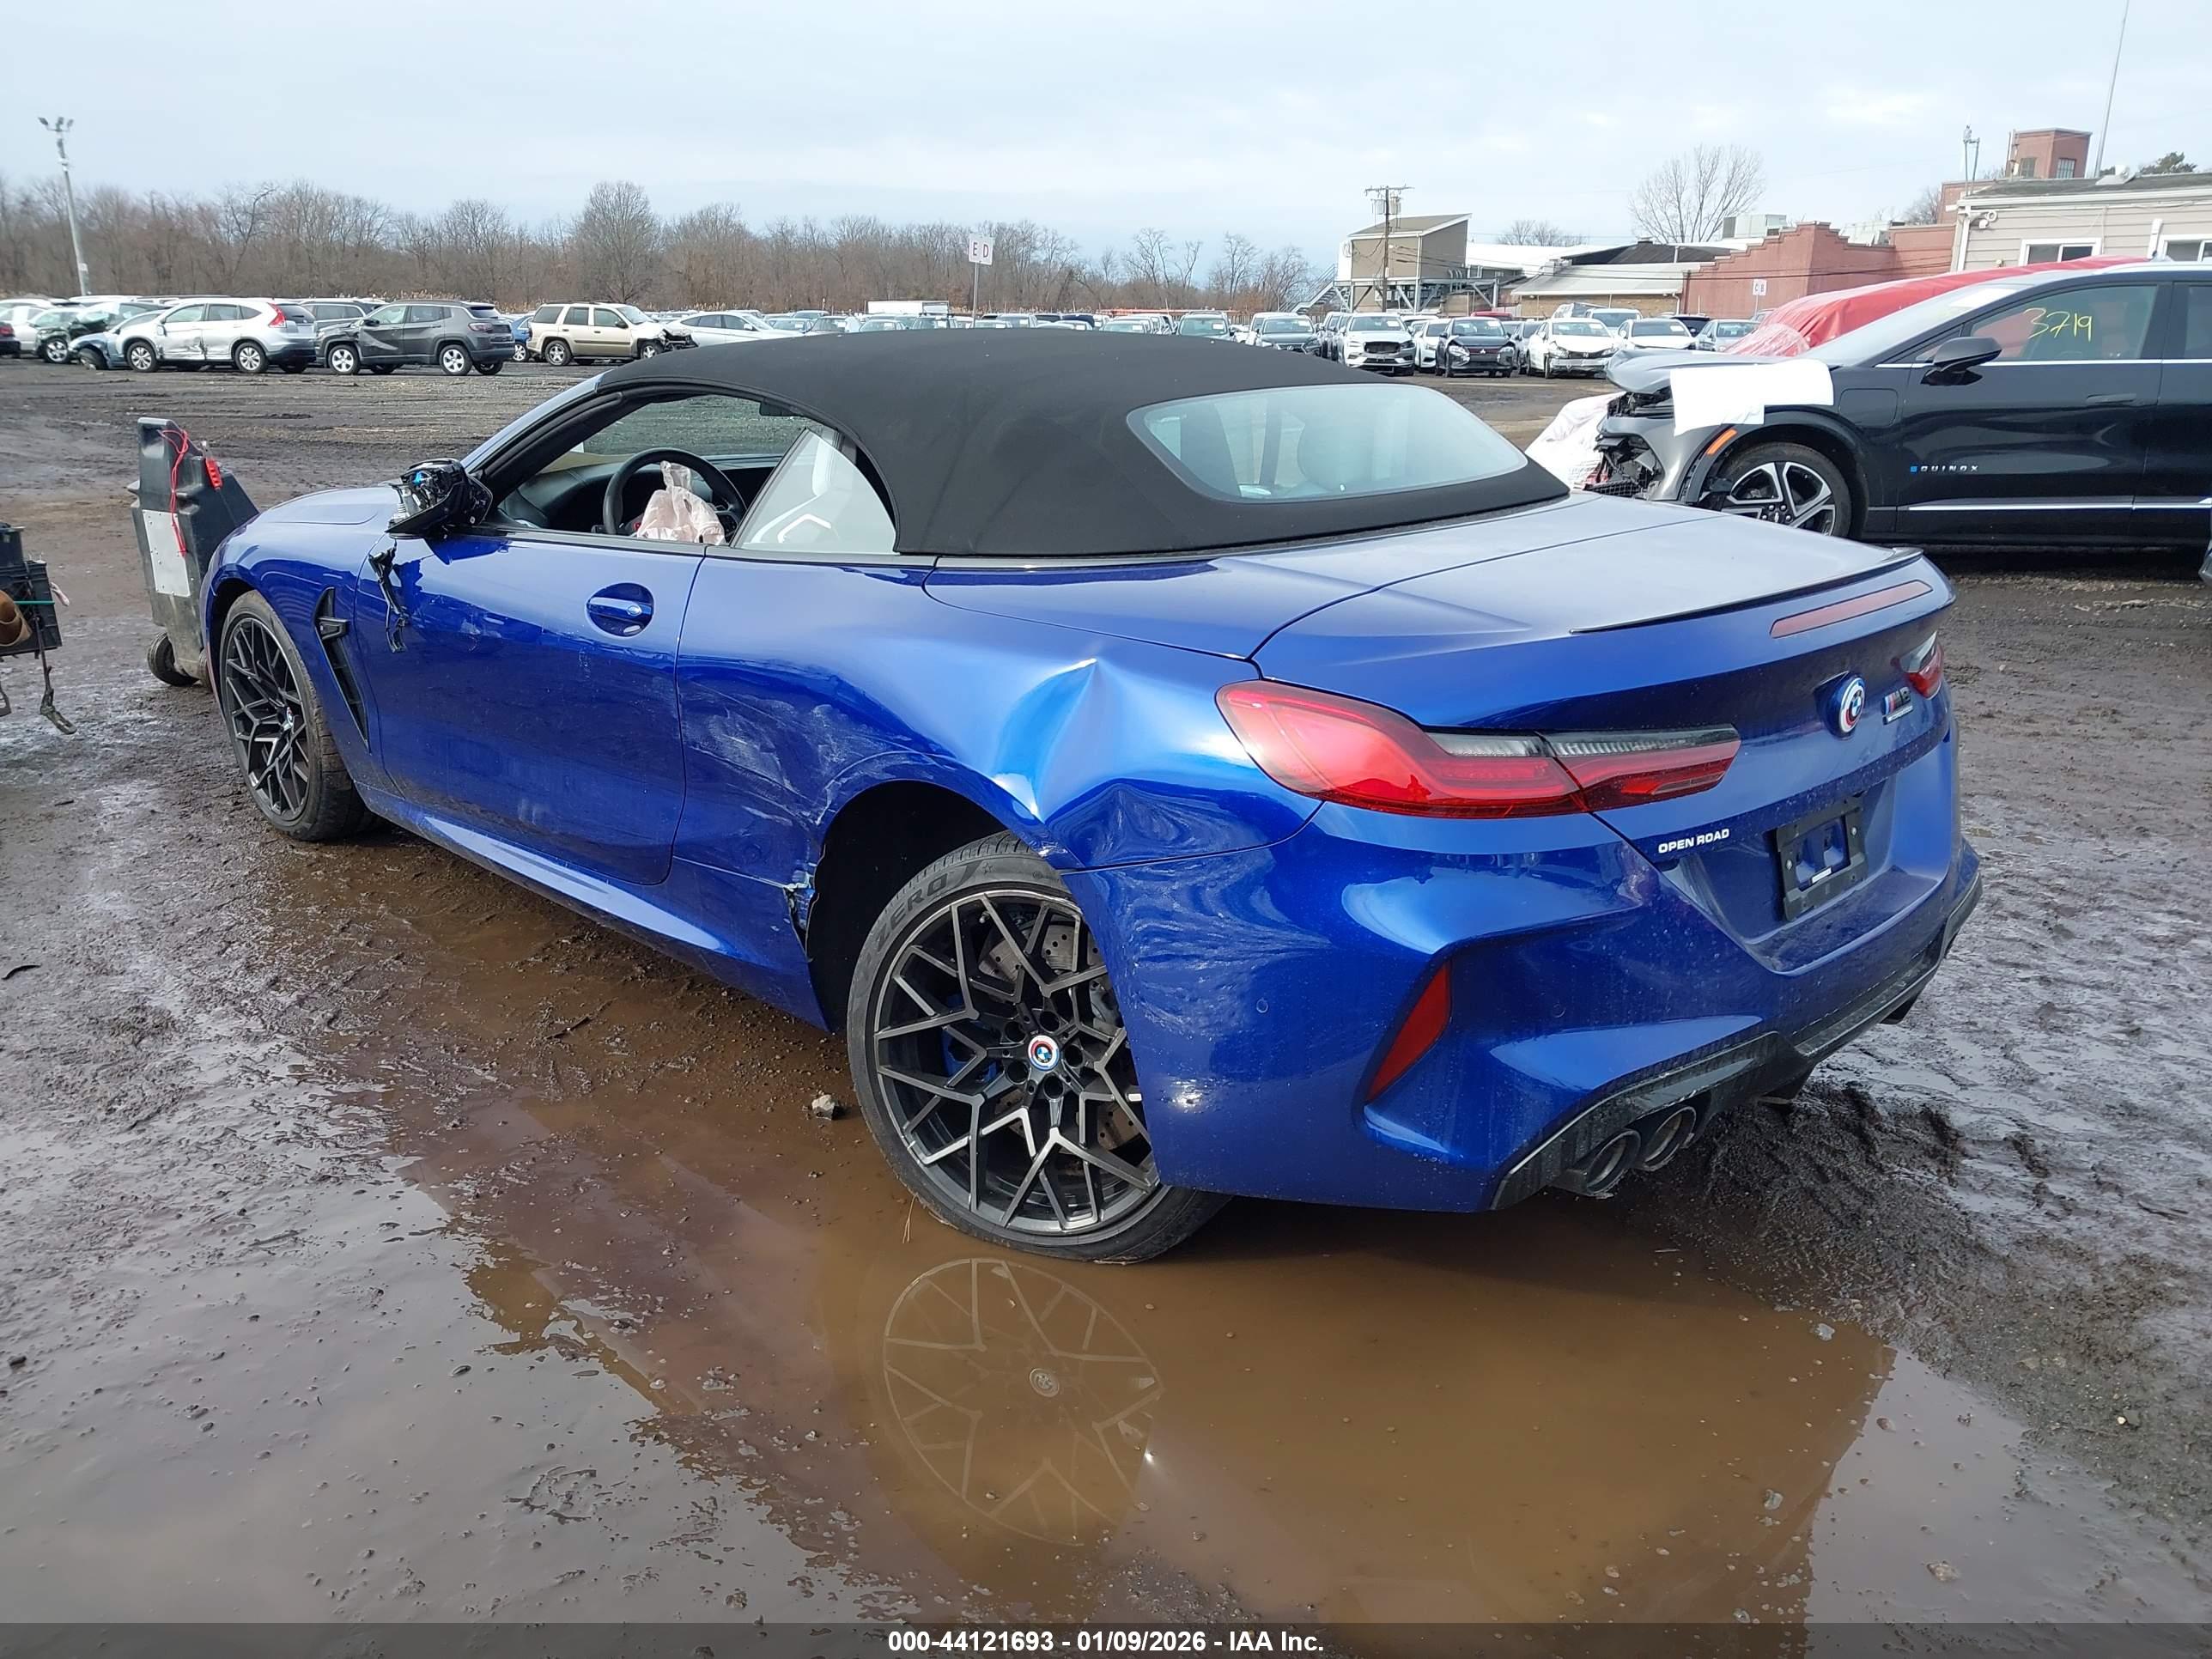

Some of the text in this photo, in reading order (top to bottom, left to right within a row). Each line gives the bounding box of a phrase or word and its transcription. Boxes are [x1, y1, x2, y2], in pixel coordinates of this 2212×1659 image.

[2022, 307, 2093, 343] 3719
[1657, 828, 1730, 854] OPEN ROAD
[875, 872, 950, 952] ZERO
